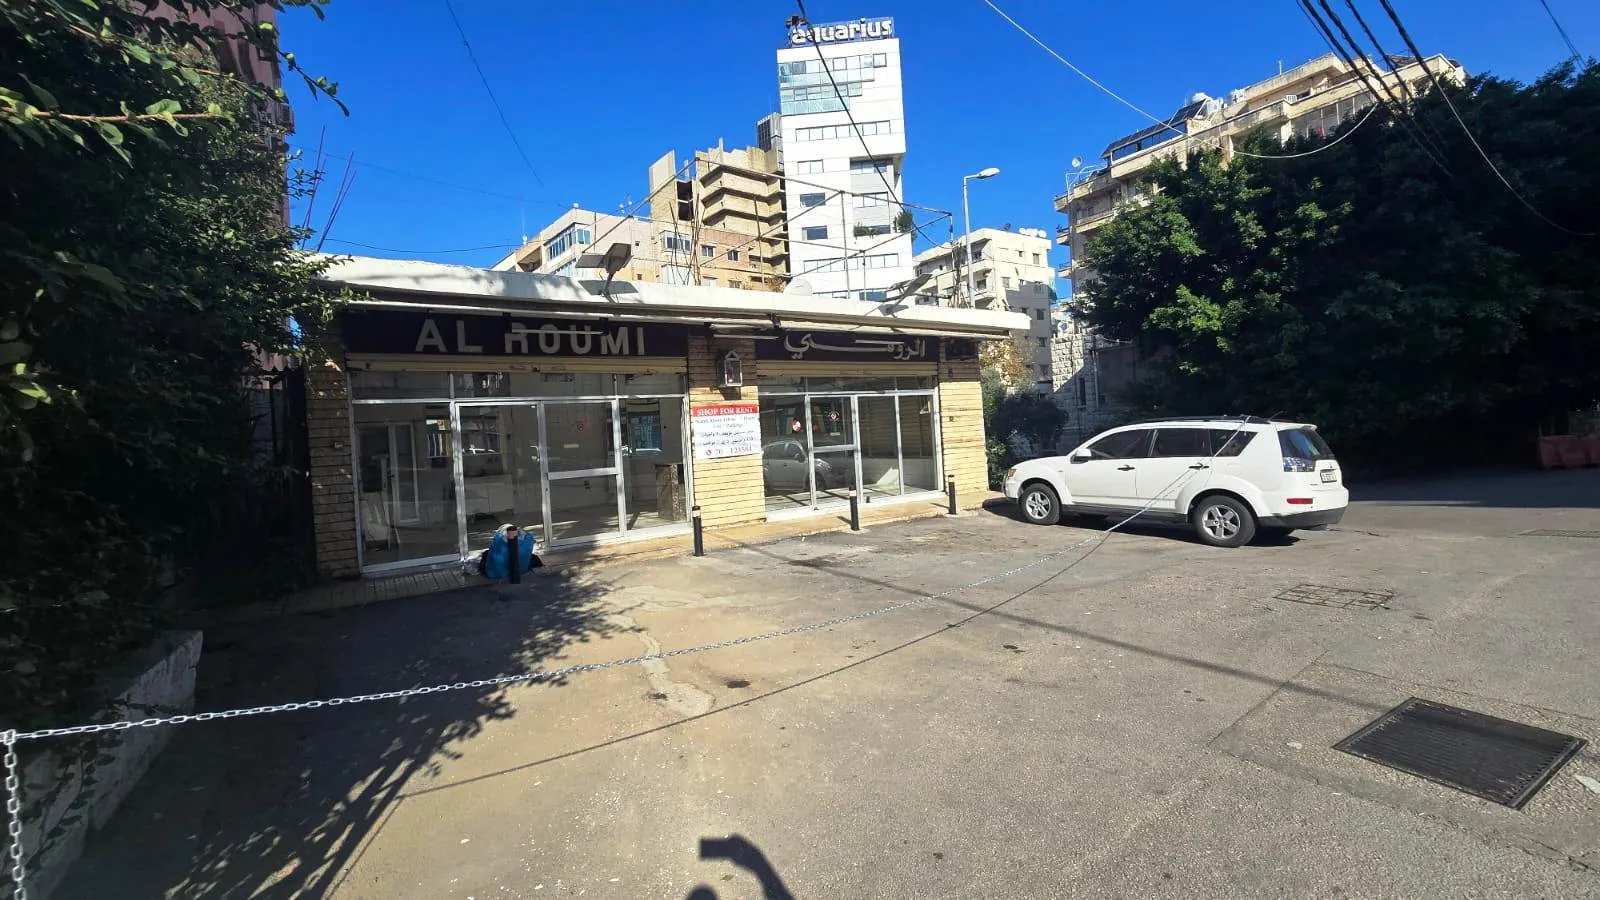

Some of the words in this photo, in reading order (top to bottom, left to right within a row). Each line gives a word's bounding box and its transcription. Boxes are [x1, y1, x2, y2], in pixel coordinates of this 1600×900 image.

[415, 318, 483, 353] AL
[504, 322, 645, 355] ROUMI
[697, 408, 718, 416] SHOP
[719, 407, 735, 415] FOR
[735, 406, 753, 414] RENT
